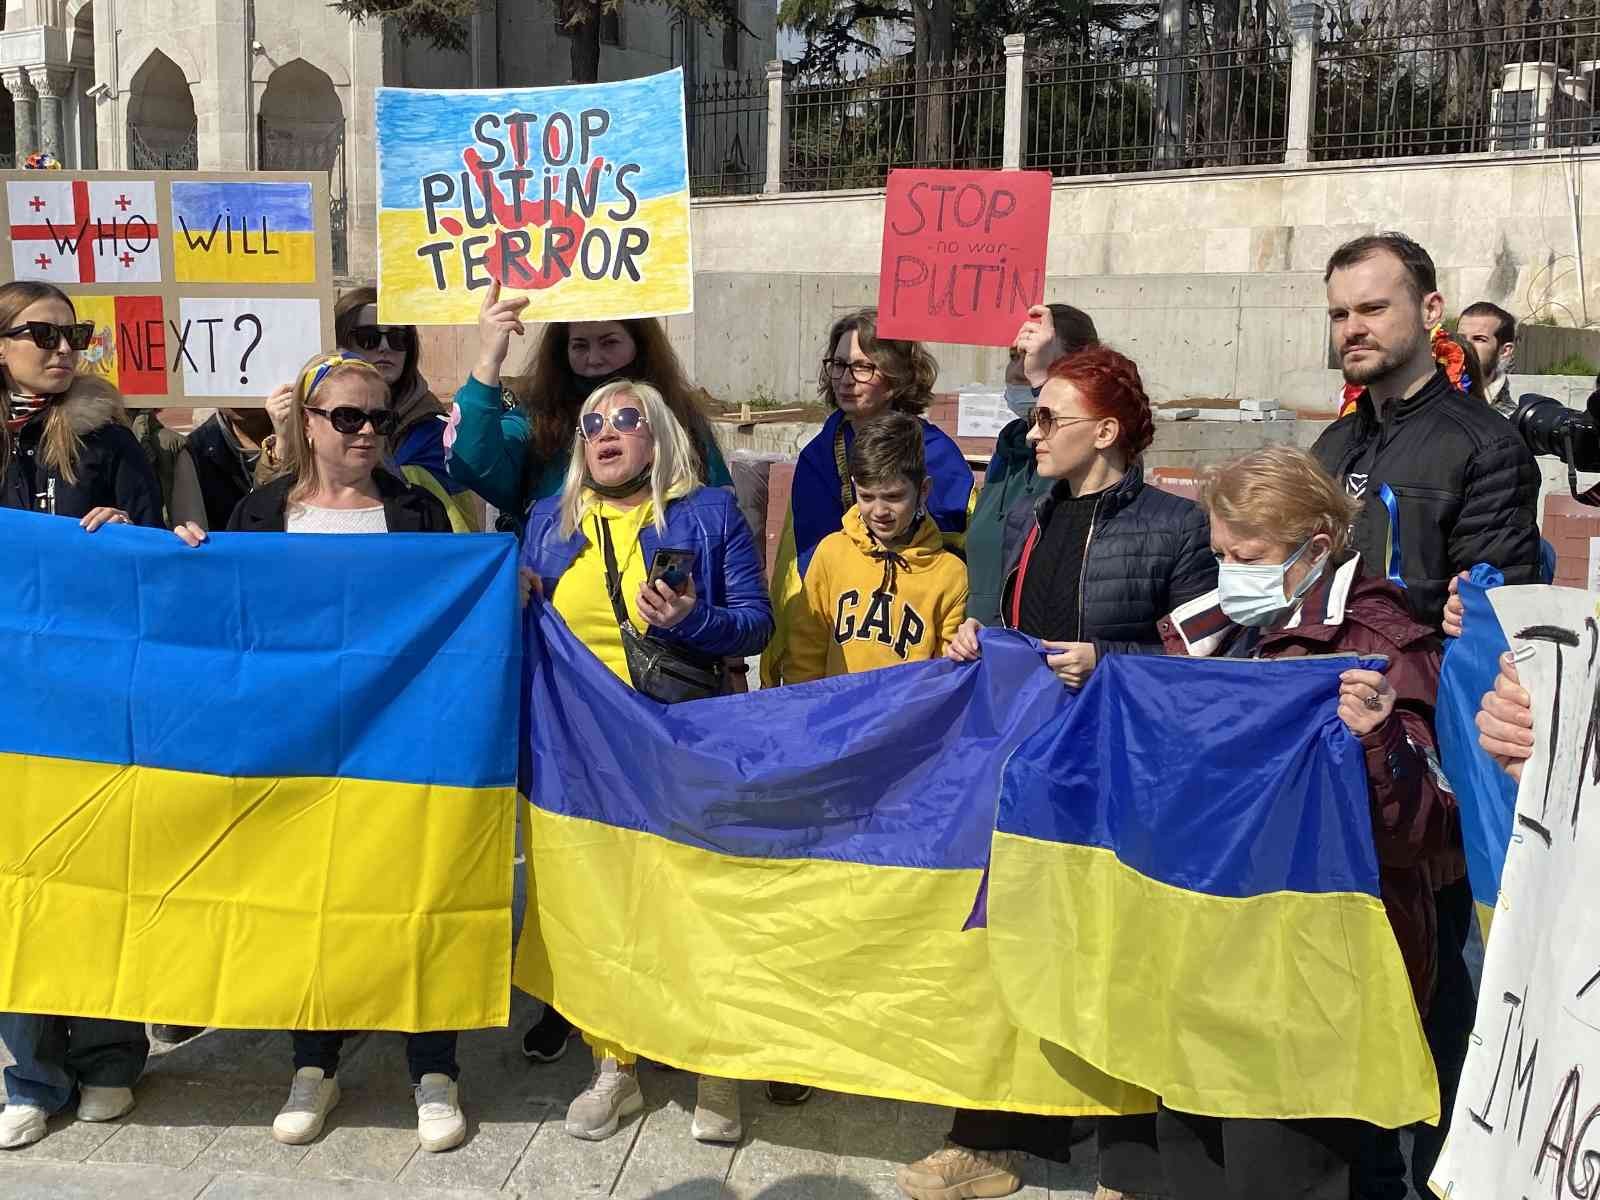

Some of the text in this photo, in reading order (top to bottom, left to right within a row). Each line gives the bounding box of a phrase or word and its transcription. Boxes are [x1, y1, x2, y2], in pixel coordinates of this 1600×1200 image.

[474, 108, 610, 169] STOP
[45, 214, 152, 256] WHO
[891, 182, 1017, 236] STOP
[417, 227, 650, 290] TERROR
[119, 313, 263, 385] NEXT?
[834, 589, 925, 660] GAP
